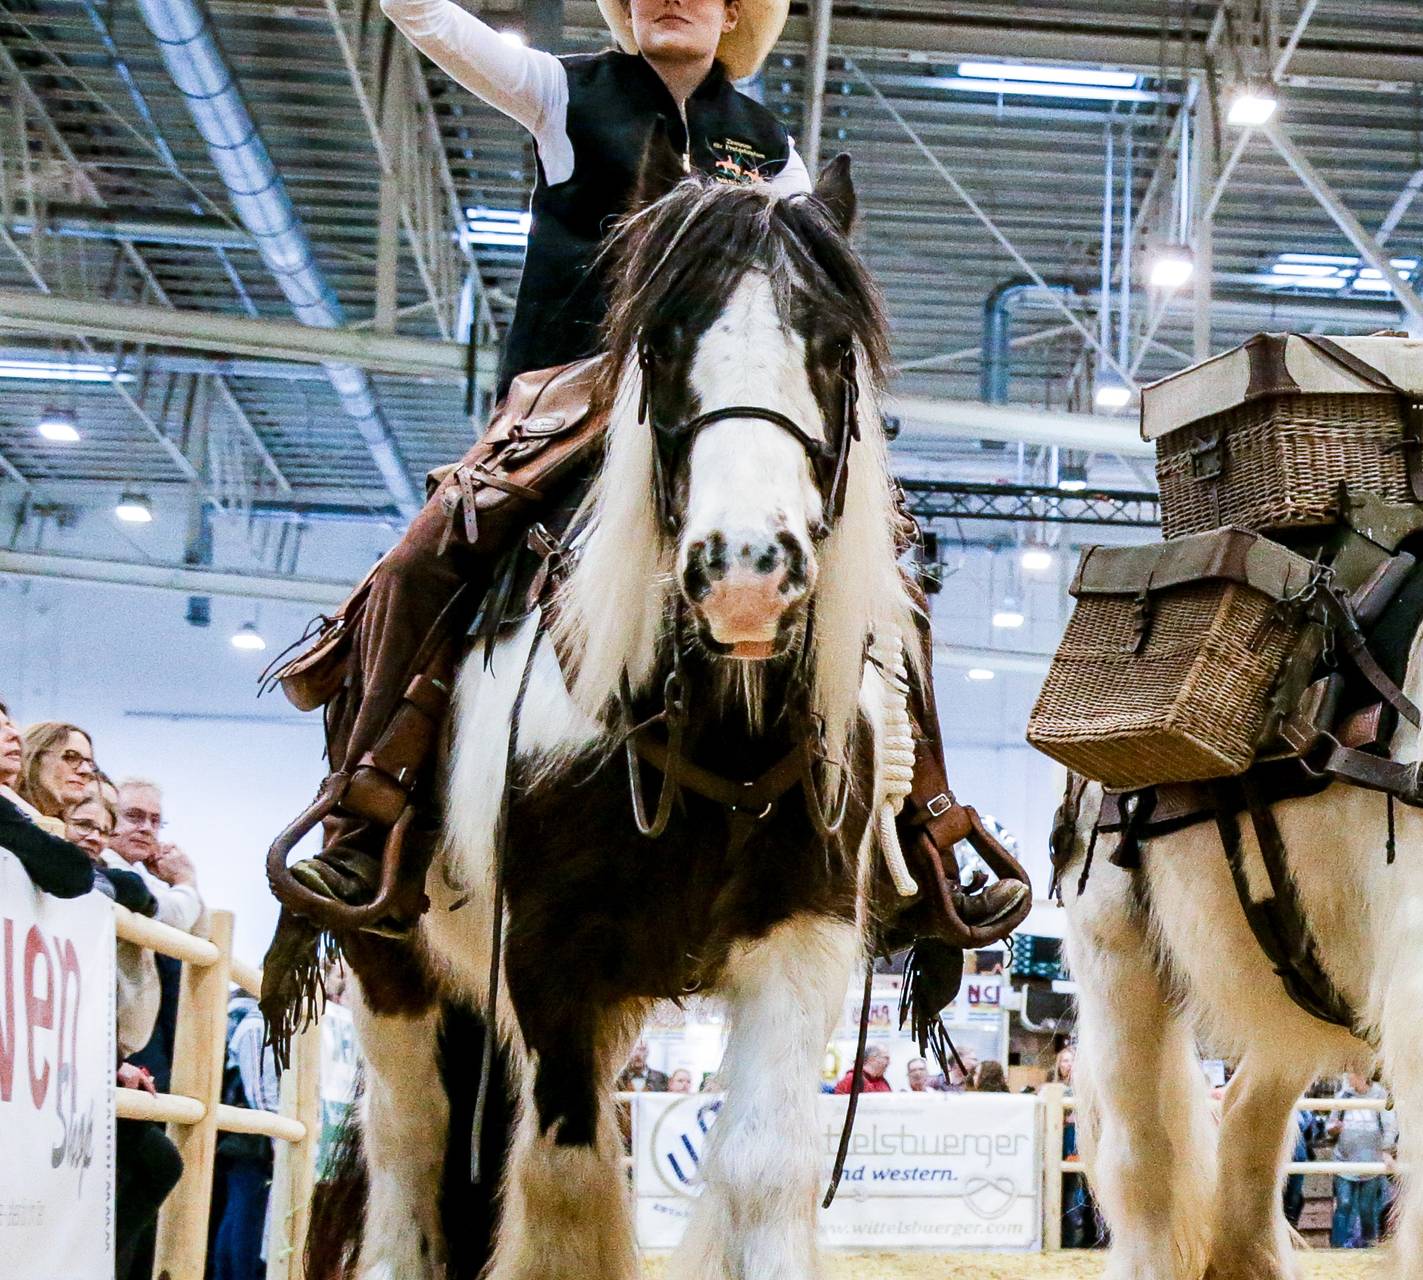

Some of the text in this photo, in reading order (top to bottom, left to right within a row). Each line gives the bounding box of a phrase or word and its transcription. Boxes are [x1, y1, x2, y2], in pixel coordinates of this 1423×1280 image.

[823, 1124, 1030, 1169] telsbuerger
[841, 1165, 959, 1182] nd western.
